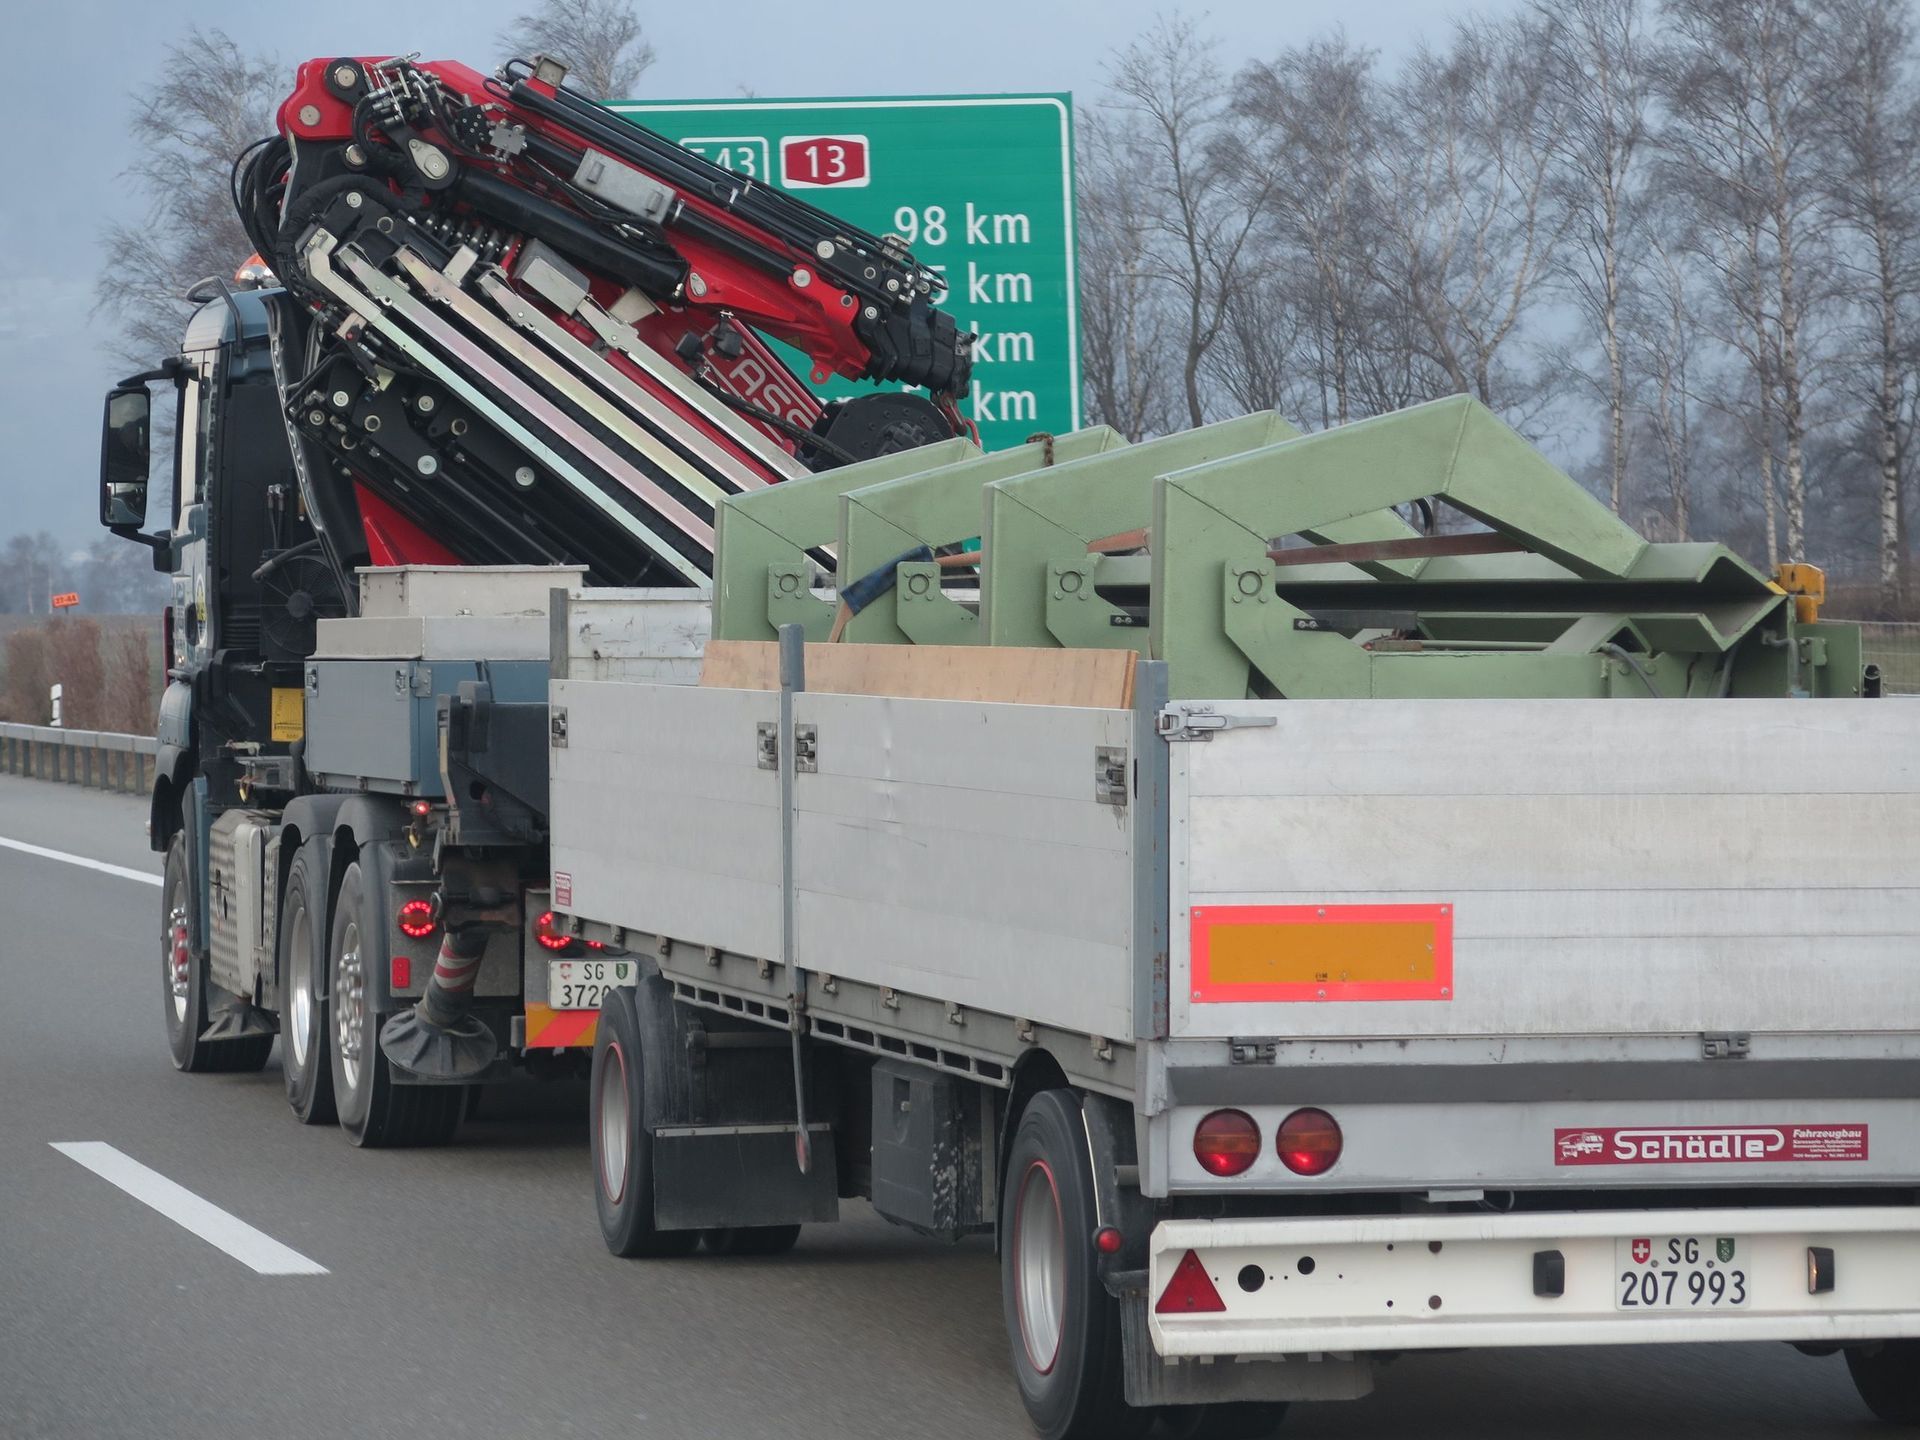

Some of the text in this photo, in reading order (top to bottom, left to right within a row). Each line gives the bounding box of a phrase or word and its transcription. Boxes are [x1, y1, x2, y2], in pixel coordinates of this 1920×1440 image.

[689, 146, 756, 178] 43
[804, 145, 846, 178] 13
[894, 202, 1031, 246] 98 km
[968, 262, 1033, 304] km
[969, 321, 1035, 362] km
[973, 380, 1037, 422] km
[583, 963, 605, 981] SG
[1793, 1128, 1862, 1139] Fahrzeugbau
[1667, 1238, 1699, 1264] SG
[1620, 1269, 1747, 1306] 207 993
